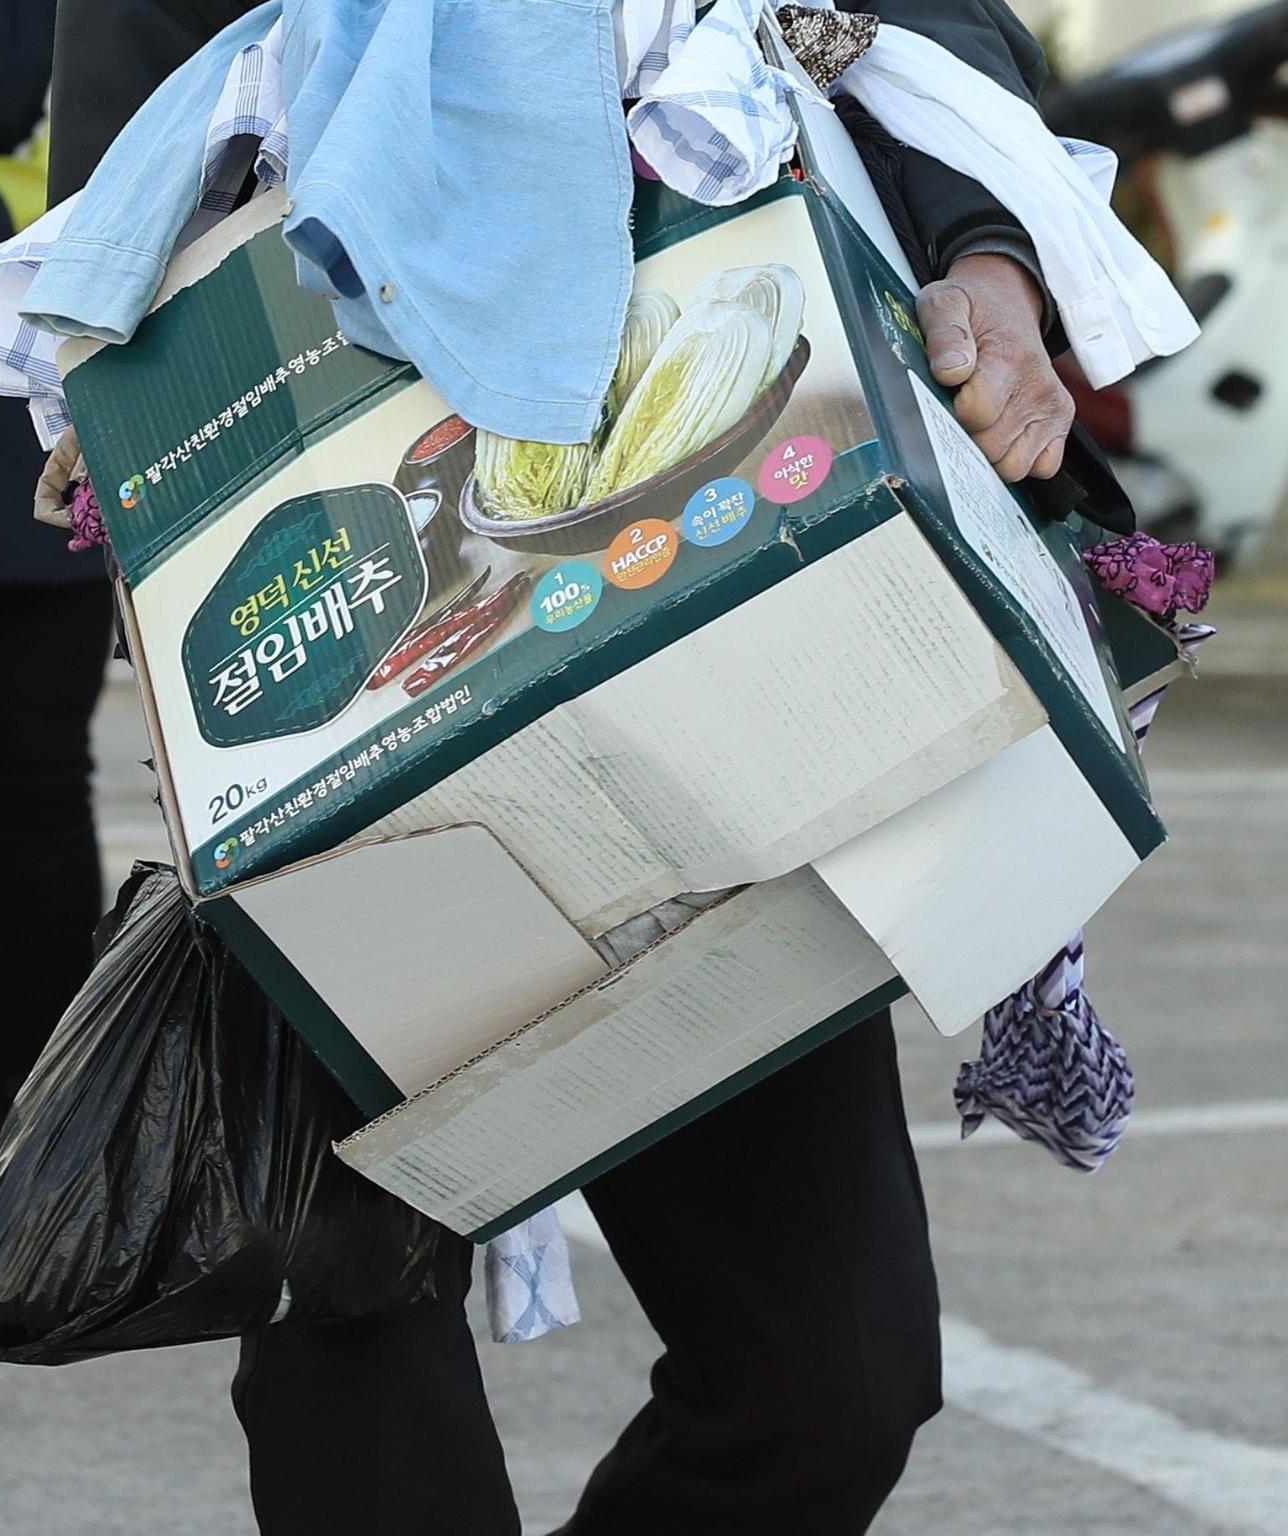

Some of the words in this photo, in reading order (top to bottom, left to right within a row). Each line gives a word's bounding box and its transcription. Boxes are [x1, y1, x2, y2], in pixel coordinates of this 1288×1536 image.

[783, 445, 796, 460] 4
[789, 472, 808, 489] 맛
[704, 488, 718, 502] 3
[630, 528, 644, 544] 2
[611, 534, 668, 575] HACCP
[230, 574, 289, 637] 영덕
[292, 527, 354, 591] 신선
[554, 572, 565, 585] 1
[540, 582, 591, 614] 100%
[209, 557, 402, 716] 절임배추
